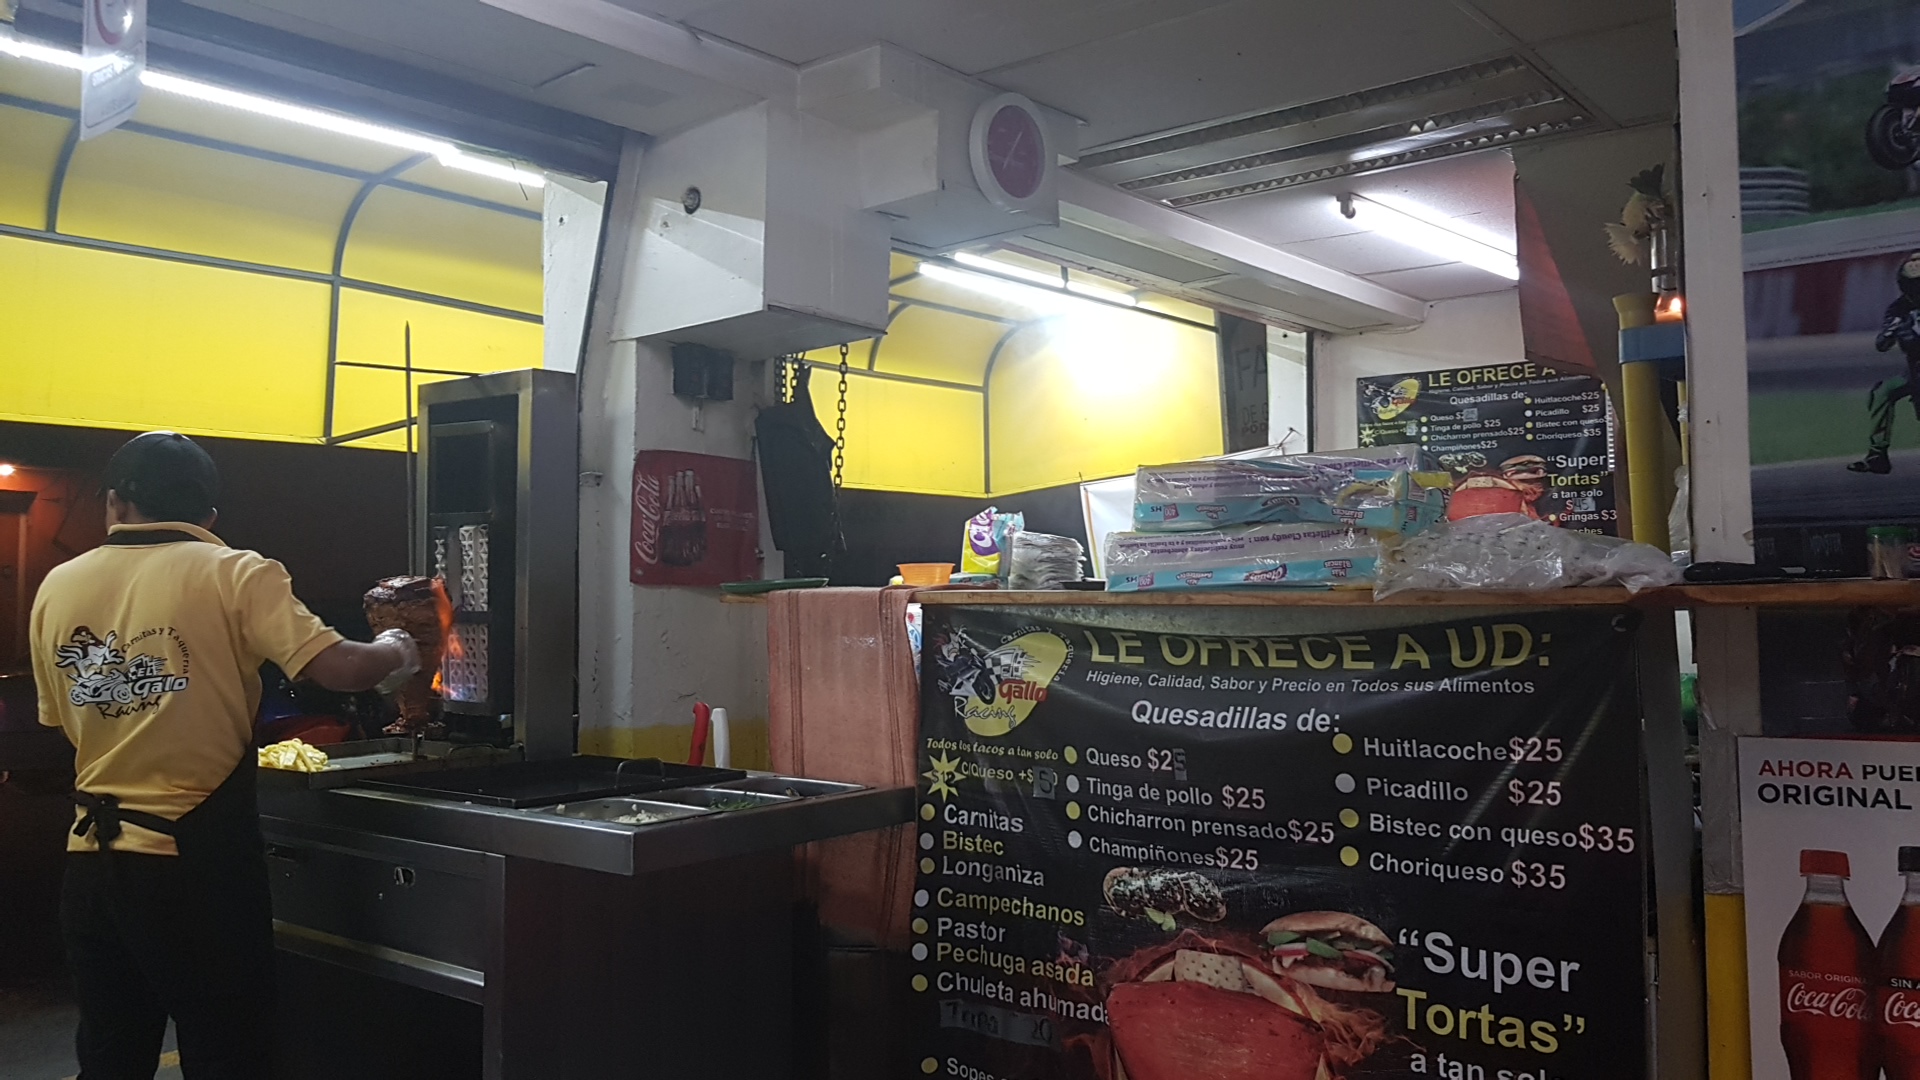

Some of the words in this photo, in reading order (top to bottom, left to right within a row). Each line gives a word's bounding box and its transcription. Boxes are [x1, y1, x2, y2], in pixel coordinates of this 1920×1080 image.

[1428, 372, 1451, 387] LE
[1457, 363, 1537, 384] OFRECE
[1450, 392, 1509, 405] Quesadillas
[1534, 395, 1581, 404] Huitlacoche
[1581, 391, 1600, 400] $25
[1535, 408, 1570, 416] Picadillo
[1582, 404, 1600, 413] $25
[1430, 414, 1454, 422] Queso
[1430, 424, 1450, 433] Tinga
[1463, 422, 1481, 430] pollo
[1484, 419, 1501, 428] $25
[1535, 420, 1560, 428] Bistec
[1579, 418, 1604, 426] queso
[1430, 433, 1471, 441] Chicharron
[1473, 430, 1508, 439] prensado
[1507, 427, 1525, 436] $25
[1430, 442, 1481, 453] Champiñones
[1480, 440, 1498, 449] $25
[1536, 431, 1582, 441] Choriqueso
[1583, 428, 1601, 437] $35
[1561, 490, 1577, 498] tan
[1580, 489, 1603, 497] solo
[634, 470, 661, 565] Coca-Cola
[1559, 512, 1599, 522] Gringas
[1001, 625, 1041, 644] Carnitas
[1084, 630, 1145, 664] LE
[1158, 635, 1374, 670] OFRECE
[1390, 633, 1431, 670] A
[1445, 623, 1551, 669] UD:
[121, 628, 157, 653] Carnitas
[159, 627, 164, 635] y
[168, 627, 189, 674] Taqueria
[1086, 670, 1143, 687] Higiene,
[1148, 673, 1205, 691] Calidad,
[1210, 675, 1255, 691] Sabor
[1257, 679, 1268, 694] y
[1272, 677, 1322, 692] Precio
[1326, 681, 1345, 692] en
[1351, 679, 1399, 692] Todos
[1403, 680, 1434, 692] sus
[1438, 677, 1535, 694] Alimentos
[954, 696, 1016, 729] Racing
[1131, 699, 1288, 731] Quesadillas
[1296, 708, 1341, 734] de:
[927, 738, 957, 751] Todos
[959, 740, 971, 753] los
[973, 742, 1005, 756] tacos
[1017, 746, 1032, 758] tan
[1034, 748, 1058, 760] solo
[1086, 747, 1142, 769] Queso
[1363, 737, 1507, 761] Huitlacoche
[1508, 736, 1563, 763] $25
[961, 761, 1014, 780] C/Queso
[1758, 760, 1853, 780] AHORA
[1086, 777, 1133, 801] Tinga
[1138, 783, 1160, 800] de
[1166, 787, 1213, 806] pollo
[1222, 784, 1266, 809] $25
[1366, 777, 1469, 801] Picadillo
[1508, 778, 1562, 806] $25
[1757, 783, 1913, 810] ORIGINAL
[944, 803, 1024, 833] Carnitas
[1087, 804, 1186, 832] Chicharron
[1192, 818, 1288, 840] prensado
[1287, 818, 1335, 844] $25
[943, 830, 1004, 856] Bistec
[1369, 813, 1441, 838] Bistec
[1448, 822, 1492, 841] con
[1500, 825, 1578, 849] queso
[1578, 823, 1635, 853] $35
[1089, 836, 1216, 866] Champiñones
[1215, 846, 1259, 871] $25
[942, 856, 1045, 887] Longaniza
[1368, 852, 1505, 884] Choriqueso
[1511, 859, 1566, 889] $35
[936, 887, 1085, 927] Campechanos
[937, 917, 1006, 942] Pastor
[936, 942, 1025, 974] Pechuga
[1031, 956, 1095, 988] asada
[1788, 969, 1822, 980] SABOR
[936, 971, 1014, 1003] Chuleta
[1890, 977, 1912, 989] SIN
[1410, 1051, 1427, 1074] a
[1437, 1052, 1484, 1080] tan
